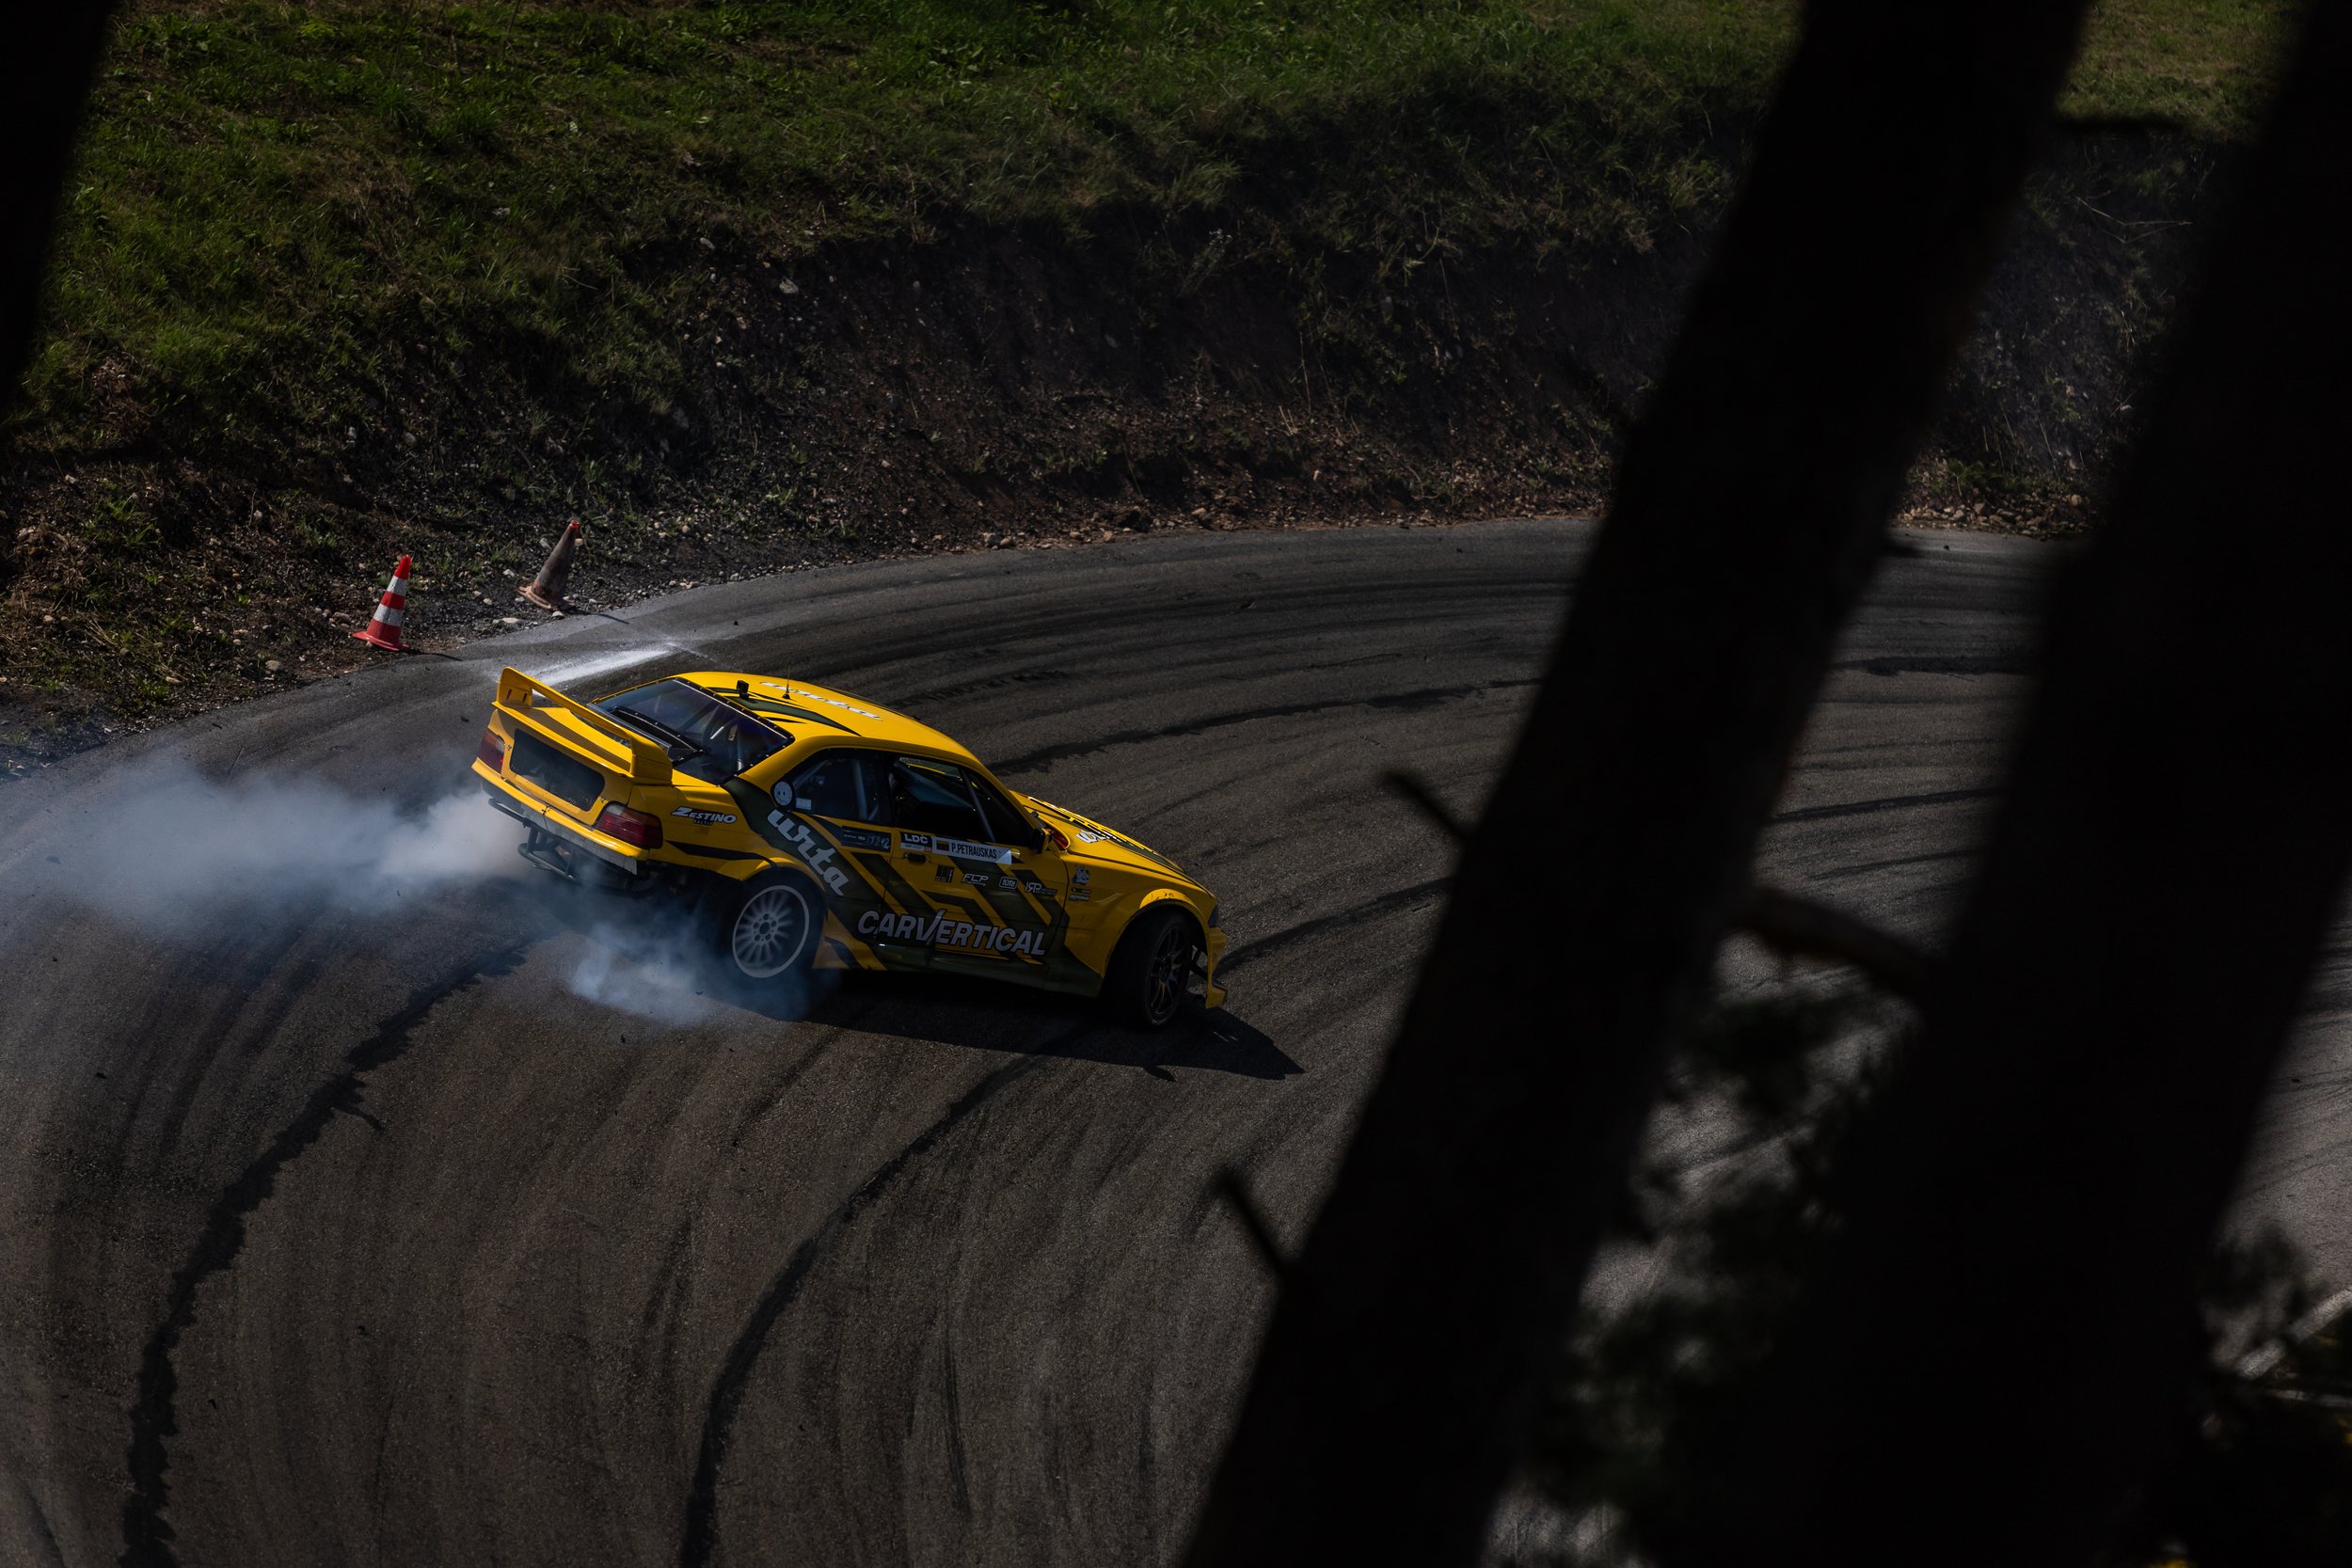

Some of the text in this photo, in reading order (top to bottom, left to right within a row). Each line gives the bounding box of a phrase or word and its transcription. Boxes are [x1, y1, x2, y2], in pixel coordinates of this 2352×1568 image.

[670, 806, 737, 823] ZESTINO
[951, 842, 997, 860] P.PETRAUSKAS
[857, 910, 1046, 956] CARVERTICAL
